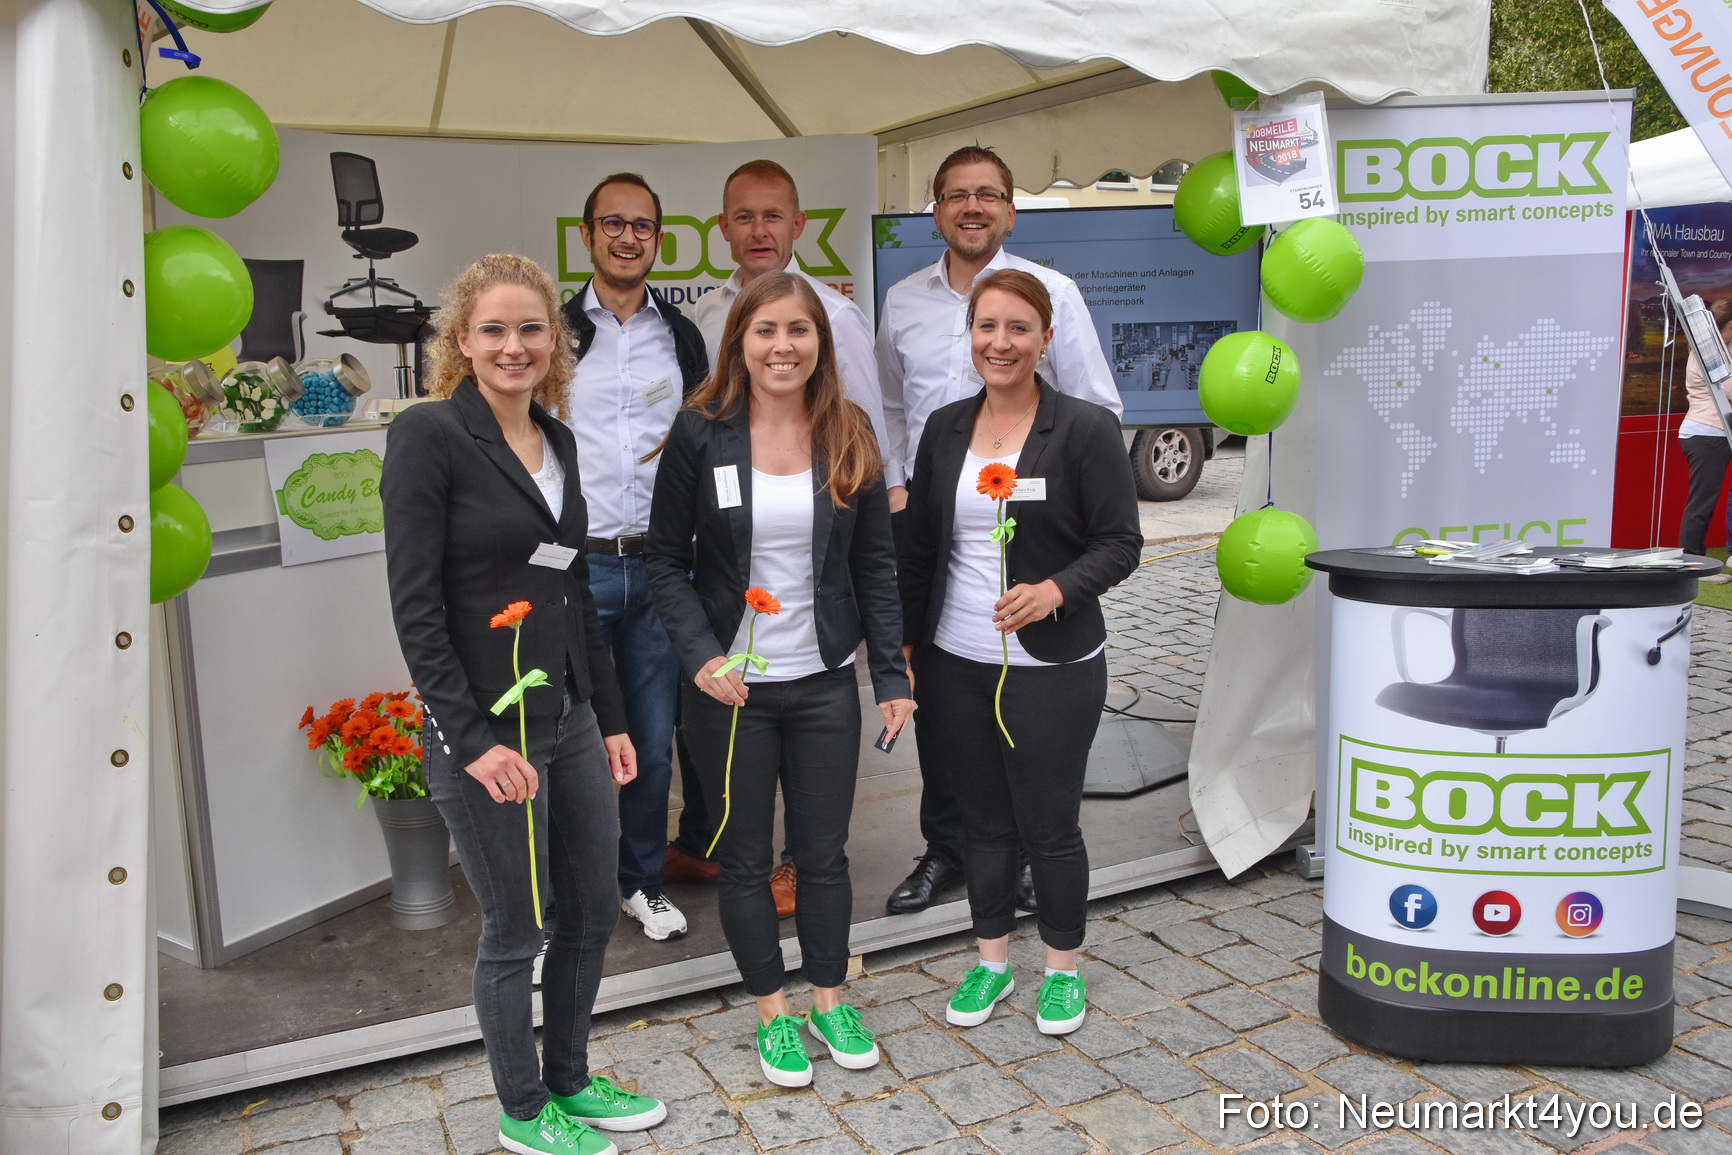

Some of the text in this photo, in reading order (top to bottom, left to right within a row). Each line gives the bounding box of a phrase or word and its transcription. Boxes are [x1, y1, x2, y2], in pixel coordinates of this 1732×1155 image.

[1251, 121, 1295, 138] JOBMEILE
[1250, 138, 1300, 152] NEUMARKT
[1277, 150, 1298, 164] 2018
[1337, 132, 1613, 202] BOCK
[1299, 191, 1325, 210] 54
[1337, 201, 1614, 229] inspired by smart concepts
[1221, 226, 1251, 249] BOC
[1675, 224, 1724, 241] Hausbau
[1650, 249, 1679, 258] reionaler
[1681, 249, 1695, 257] Town
[1697, 250, 1708, 258] and
[1709, 250, 1732, 260] Country
[1075, 271, 1088, 279] der
[1091, 270, 1137, 279] Maschinen
[1140, 269, 1157, 277] und
[1158, 268, 1194, 278] Anlagen
[1079, 284, 1146, 294] ripheriegeräten
[1265, 345, 1281, 384] BOCK
[301, 478, 380, 509] Candy Ba
[1350, 757, 1653, 837] BOCK
[1348, 823, 1653, 863] inspired by smart concepts
[1346, 943, 1644, 1001] bockonline.de
